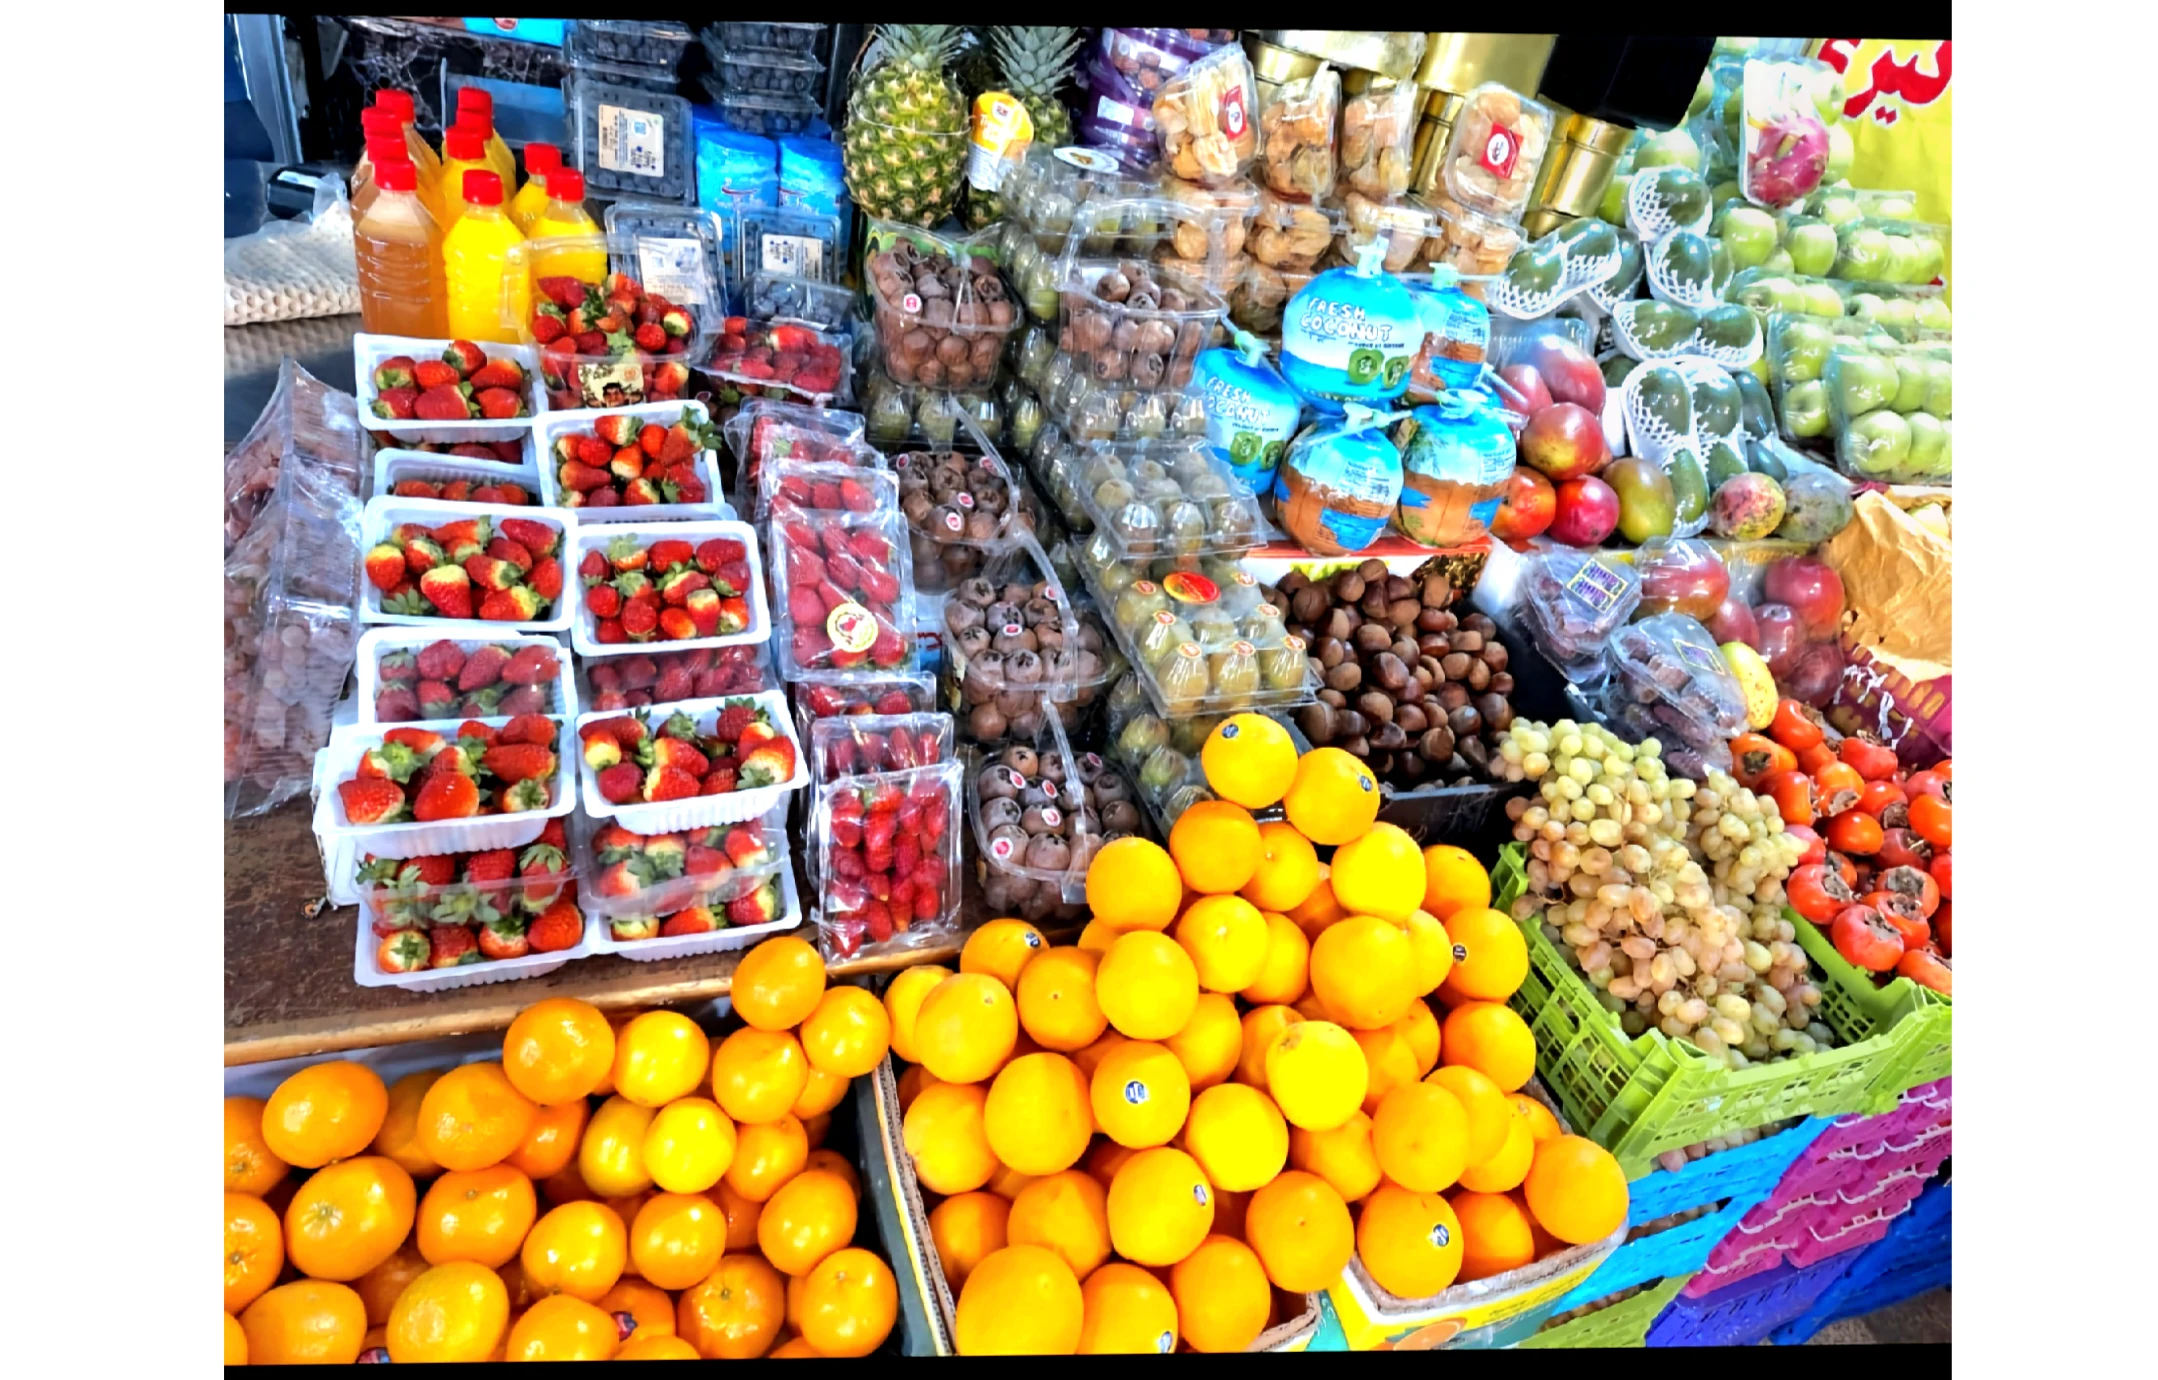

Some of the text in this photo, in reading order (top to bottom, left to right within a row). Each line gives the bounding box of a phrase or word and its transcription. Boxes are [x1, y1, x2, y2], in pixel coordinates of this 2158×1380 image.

[1307, 297, 1366, 322] FRESH
[1300, 312, 1393, 342] COCONUT
[1206, 376, 1251, 403] FRESH
